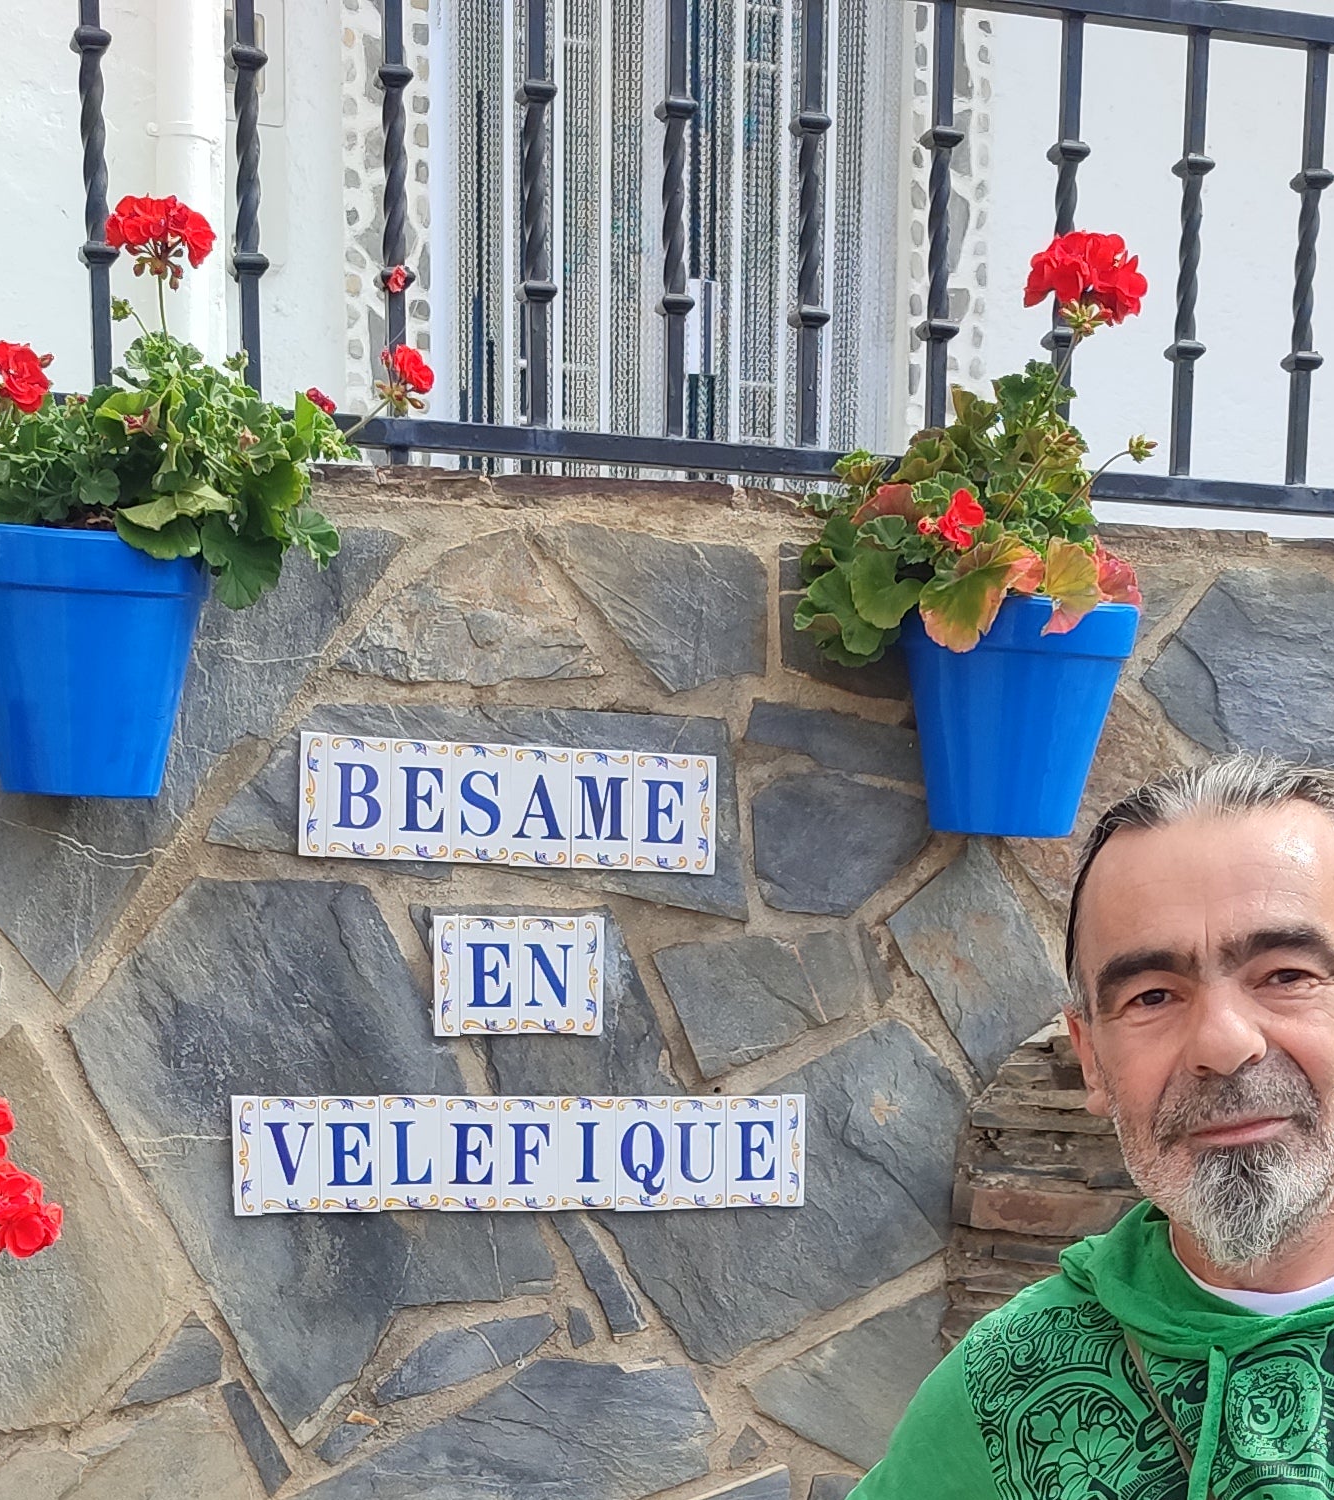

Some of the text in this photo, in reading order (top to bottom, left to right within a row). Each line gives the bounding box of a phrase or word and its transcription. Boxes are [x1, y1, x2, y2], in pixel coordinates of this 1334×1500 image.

[332, 761, 684, 845] BESAME
[467, 942, 577, 1009] EN
[263, 1120, 776, 1197] VELEFIQUE
